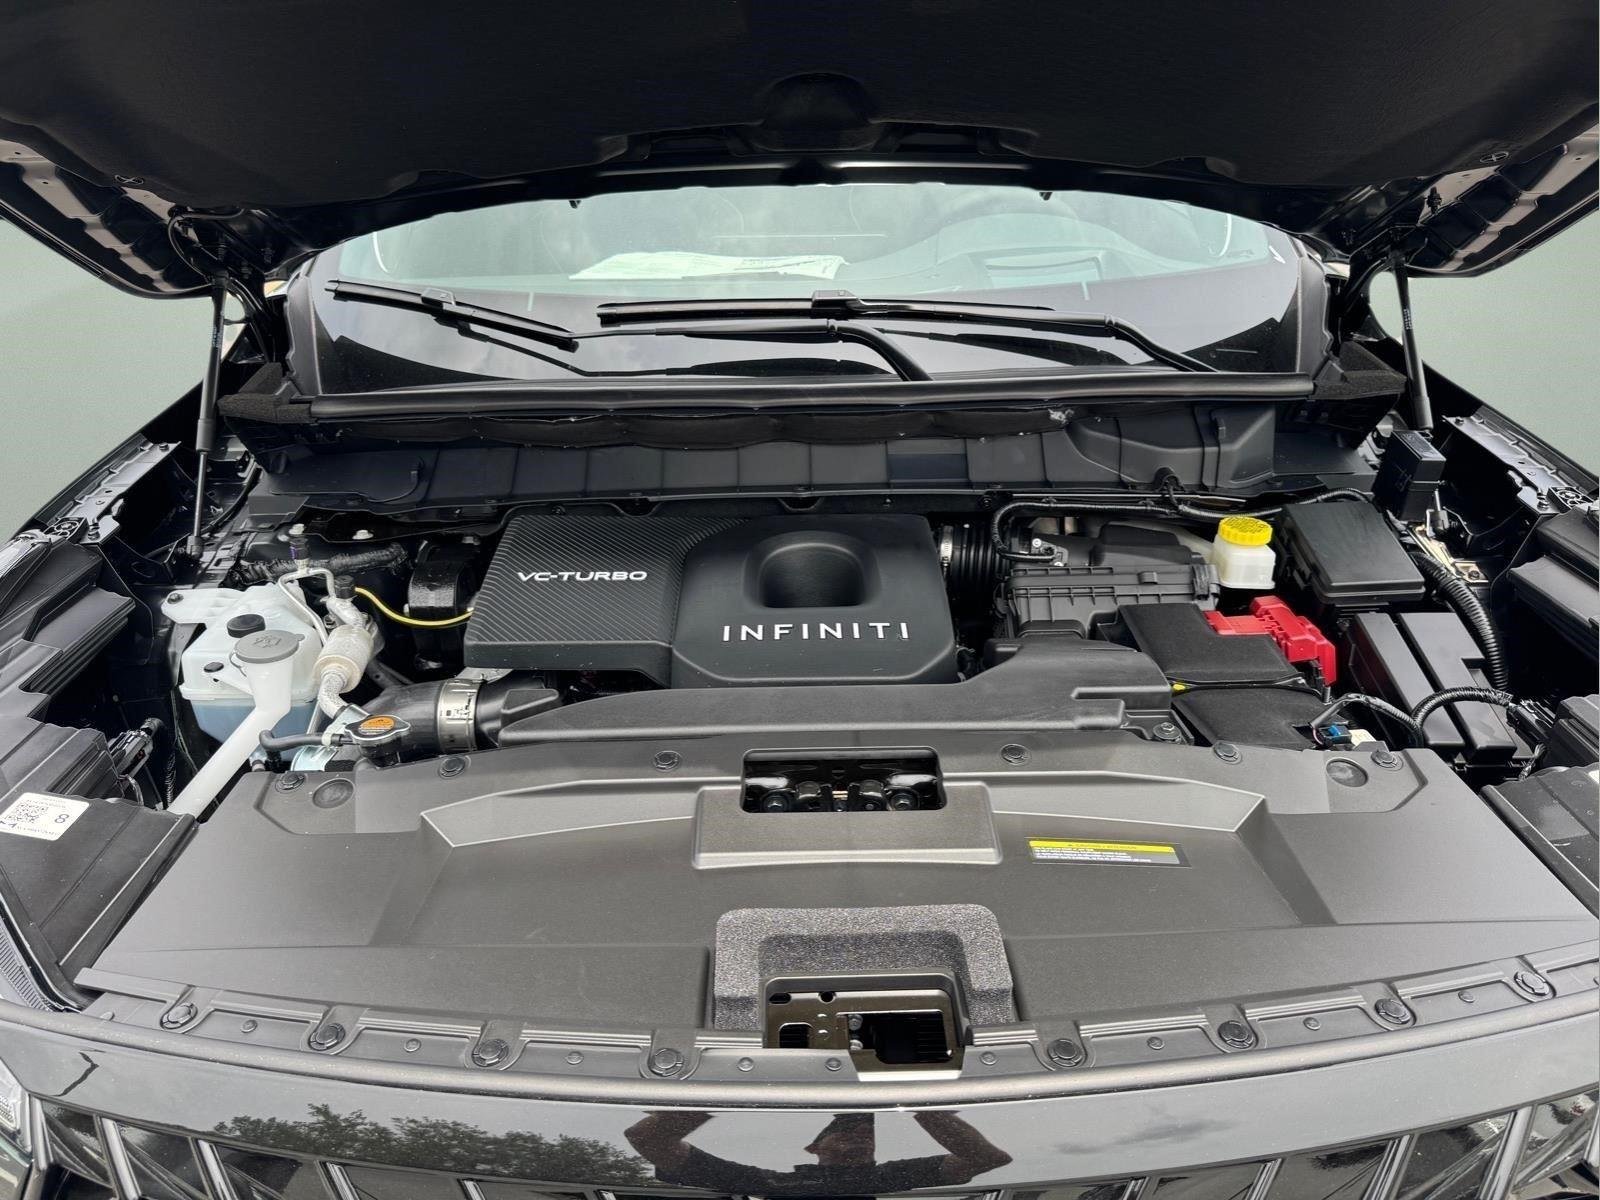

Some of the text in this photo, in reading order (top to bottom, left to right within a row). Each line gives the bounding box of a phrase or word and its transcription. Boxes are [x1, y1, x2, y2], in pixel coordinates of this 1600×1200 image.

[517, 571, 648, 581] VC-TURBO
[722, 622, 909, 642] INFINITI
[54, 813, 70, 824] 8
